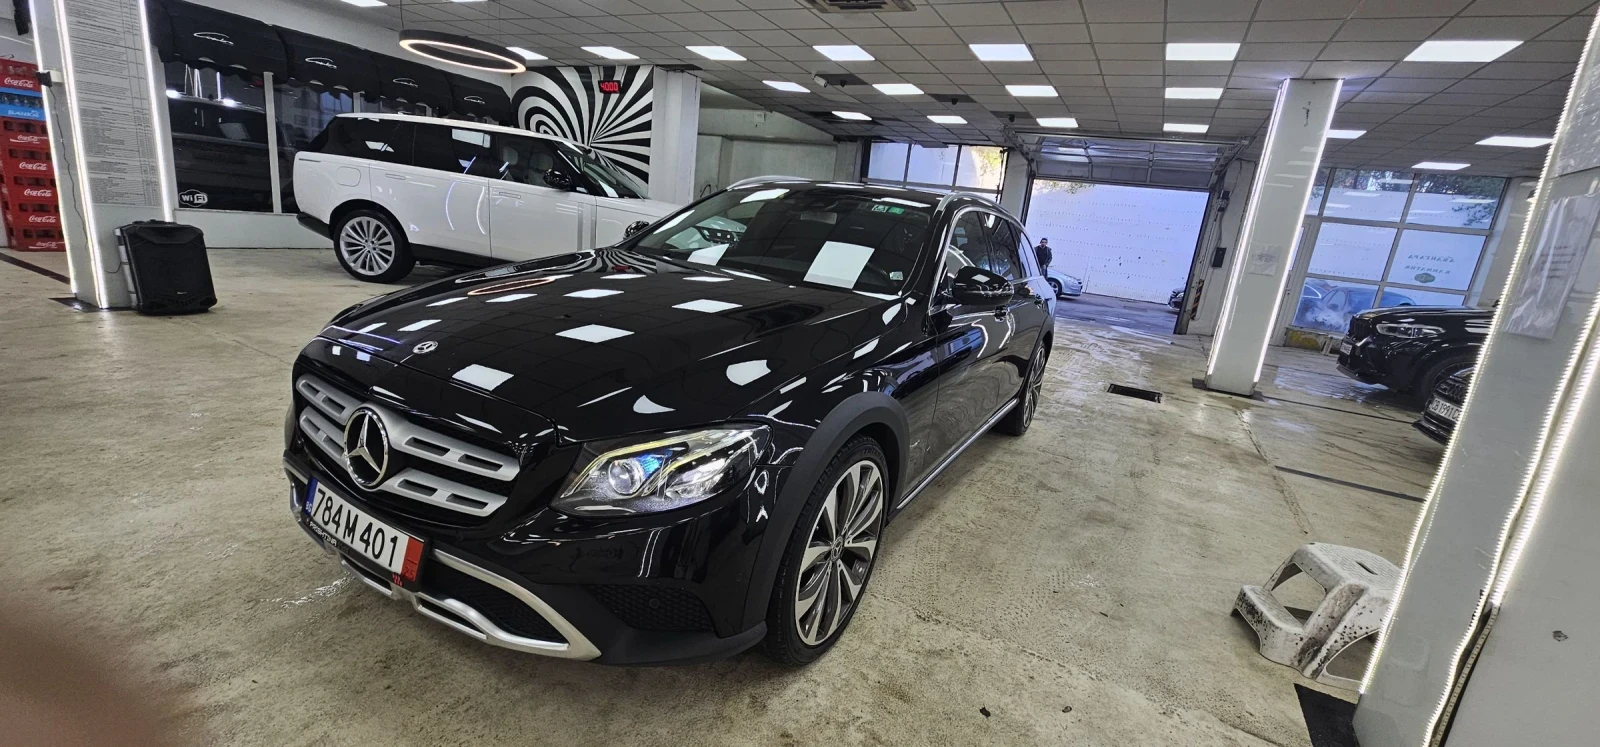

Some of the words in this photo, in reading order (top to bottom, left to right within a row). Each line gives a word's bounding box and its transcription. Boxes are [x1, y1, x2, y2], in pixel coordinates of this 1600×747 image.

[4, 77, 34, 88] Coca-Cola
[19, 161, 48, 171] Coca-Cola
[24, 188, 53, 197] Coca-Cola
[29, 215, 57, 223] Coca-Cola
